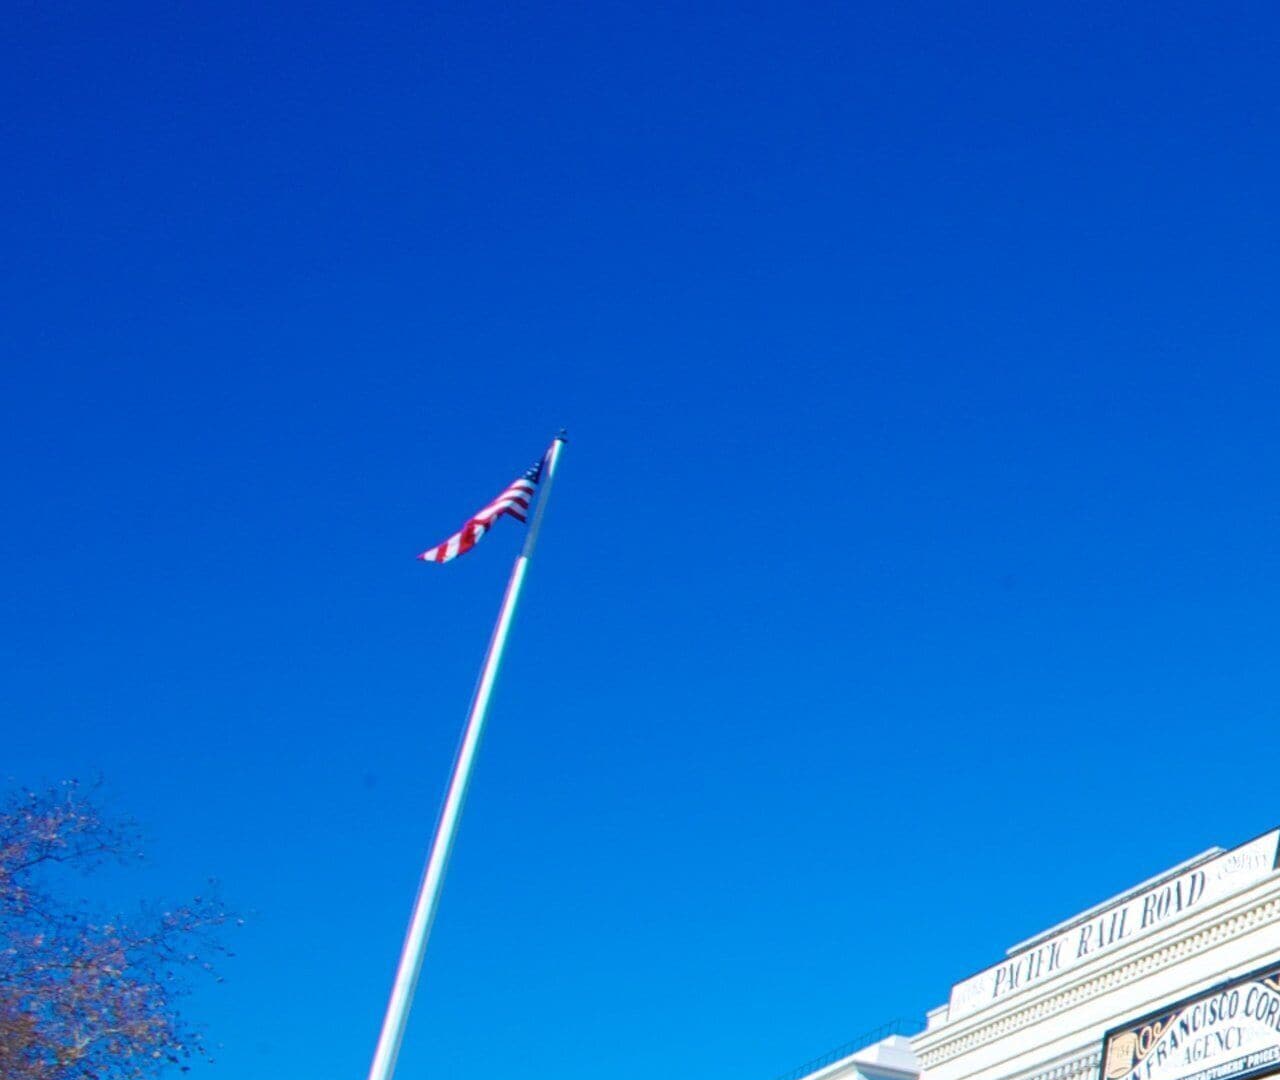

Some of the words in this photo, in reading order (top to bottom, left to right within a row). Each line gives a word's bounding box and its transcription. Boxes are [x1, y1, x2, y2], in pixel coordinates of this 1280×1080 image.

[992, 937, 1069, 998] PACIFIC
[1077, 907, 1133, 958] RAIL
[1140, 870, 1206, 929] ROAD
[1146, 989, 1239, 1080] FRANCISCO
[1183, 1026, 1246, 1066] AGENCY
